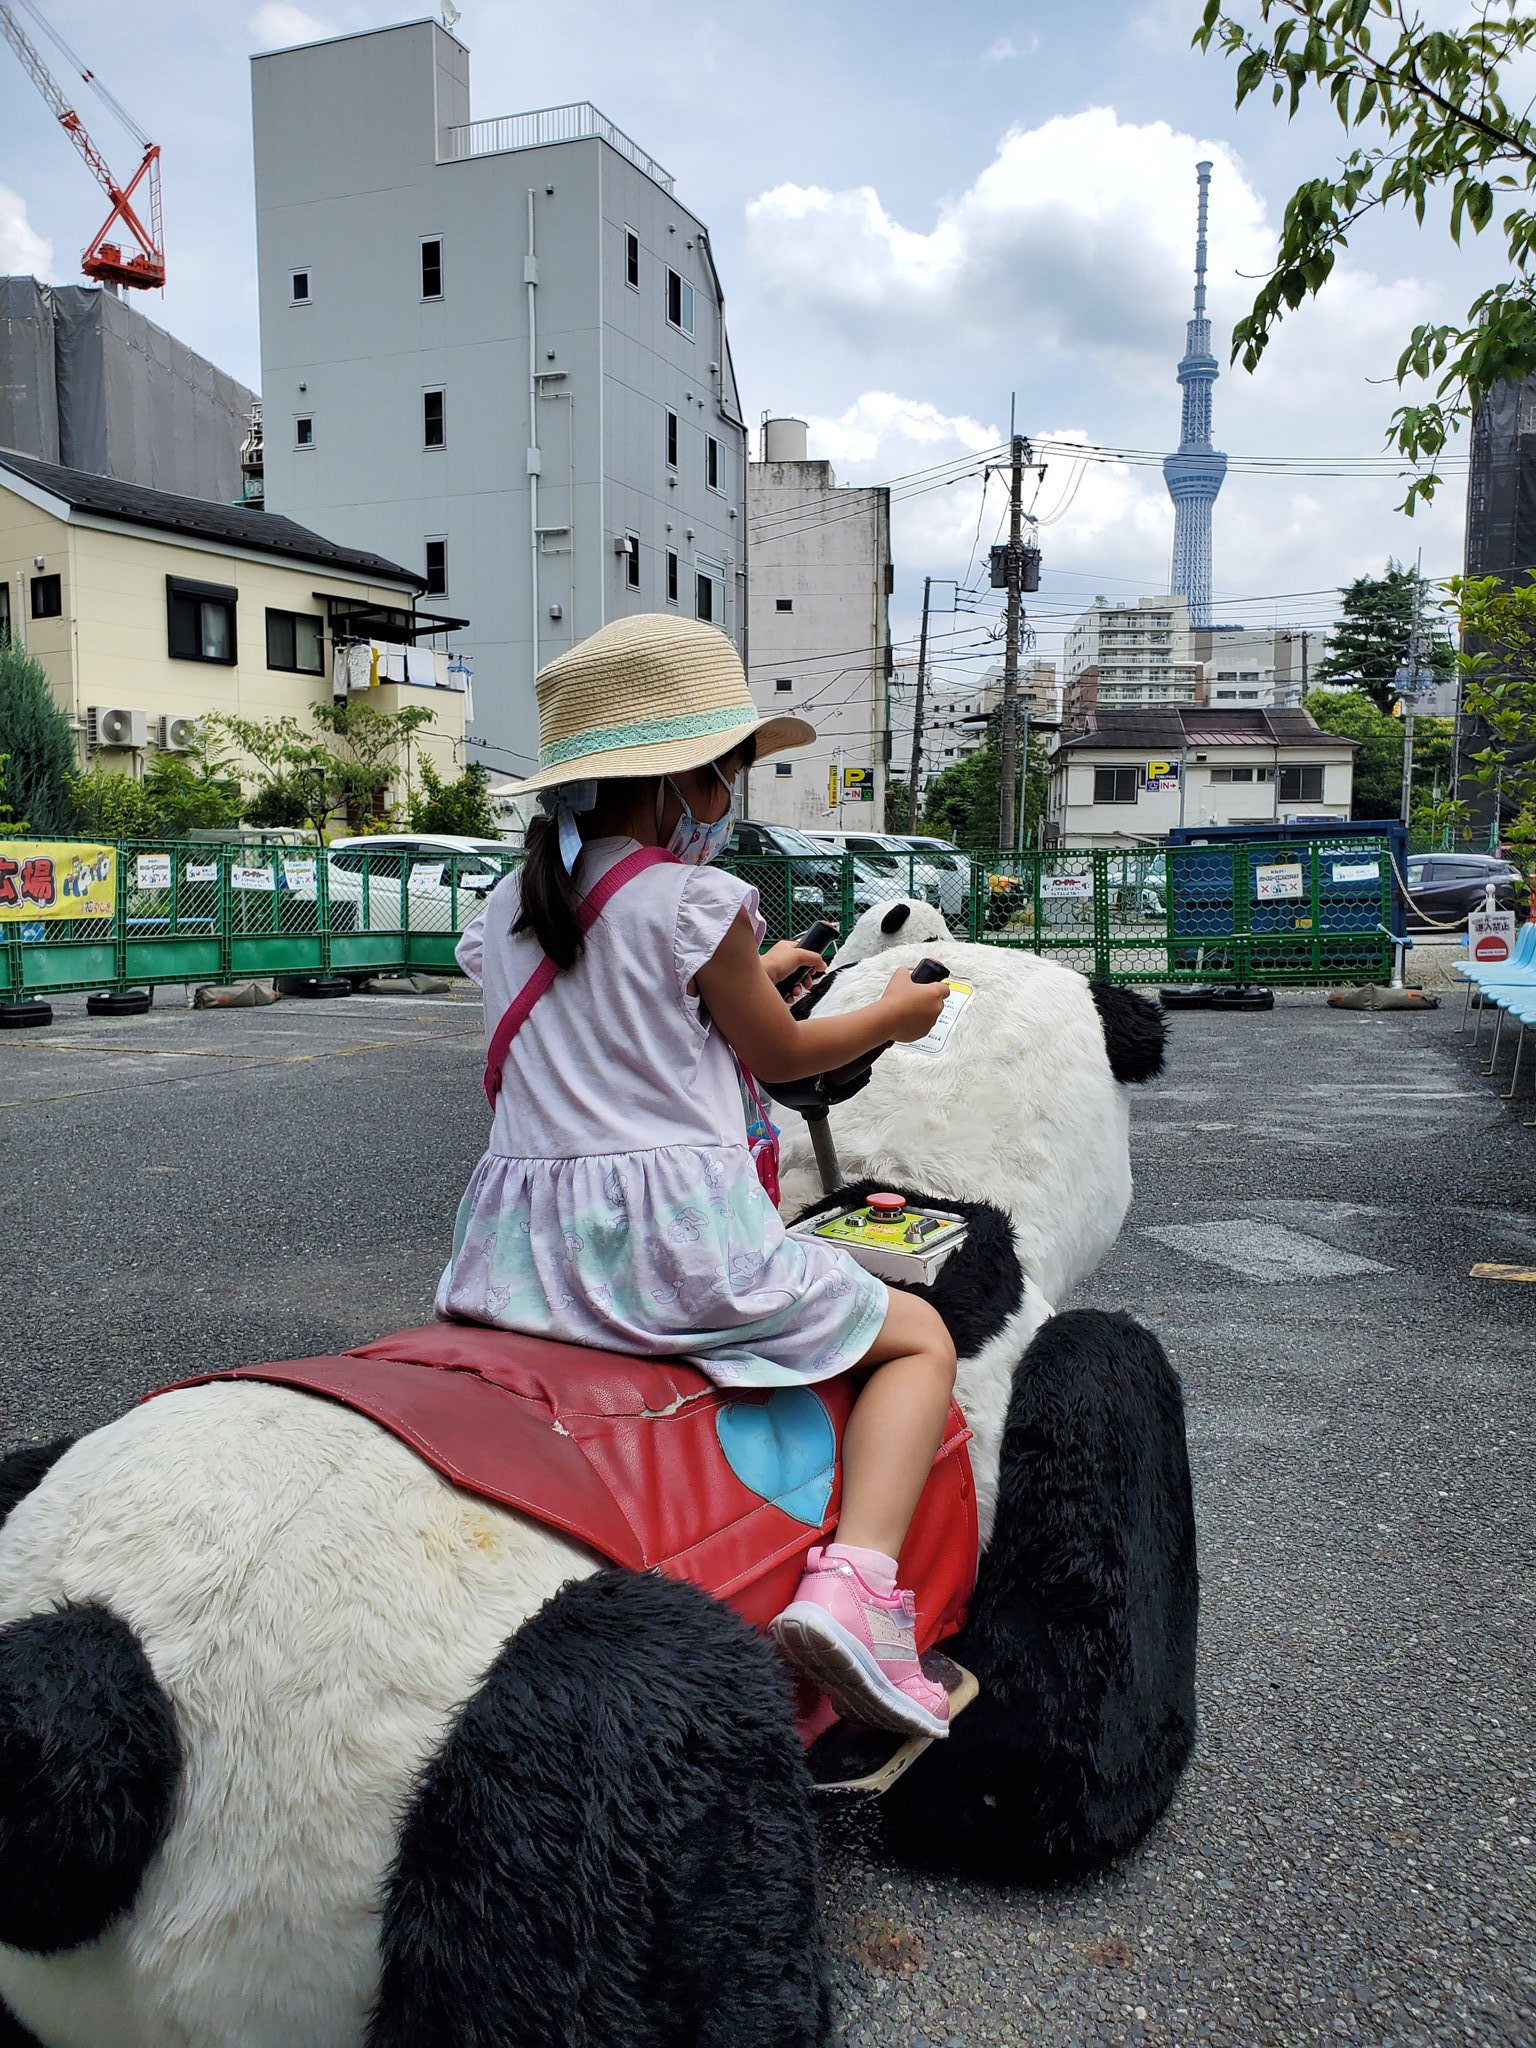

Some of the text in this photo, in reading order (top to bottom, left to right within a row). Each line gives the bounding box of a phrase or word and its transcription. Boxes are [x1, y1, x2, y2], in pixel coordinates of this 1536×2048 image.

[845, 768, 865, 787] P
[1149, 762, 1170, 779] P
[851, 790, 861, 798] IN
